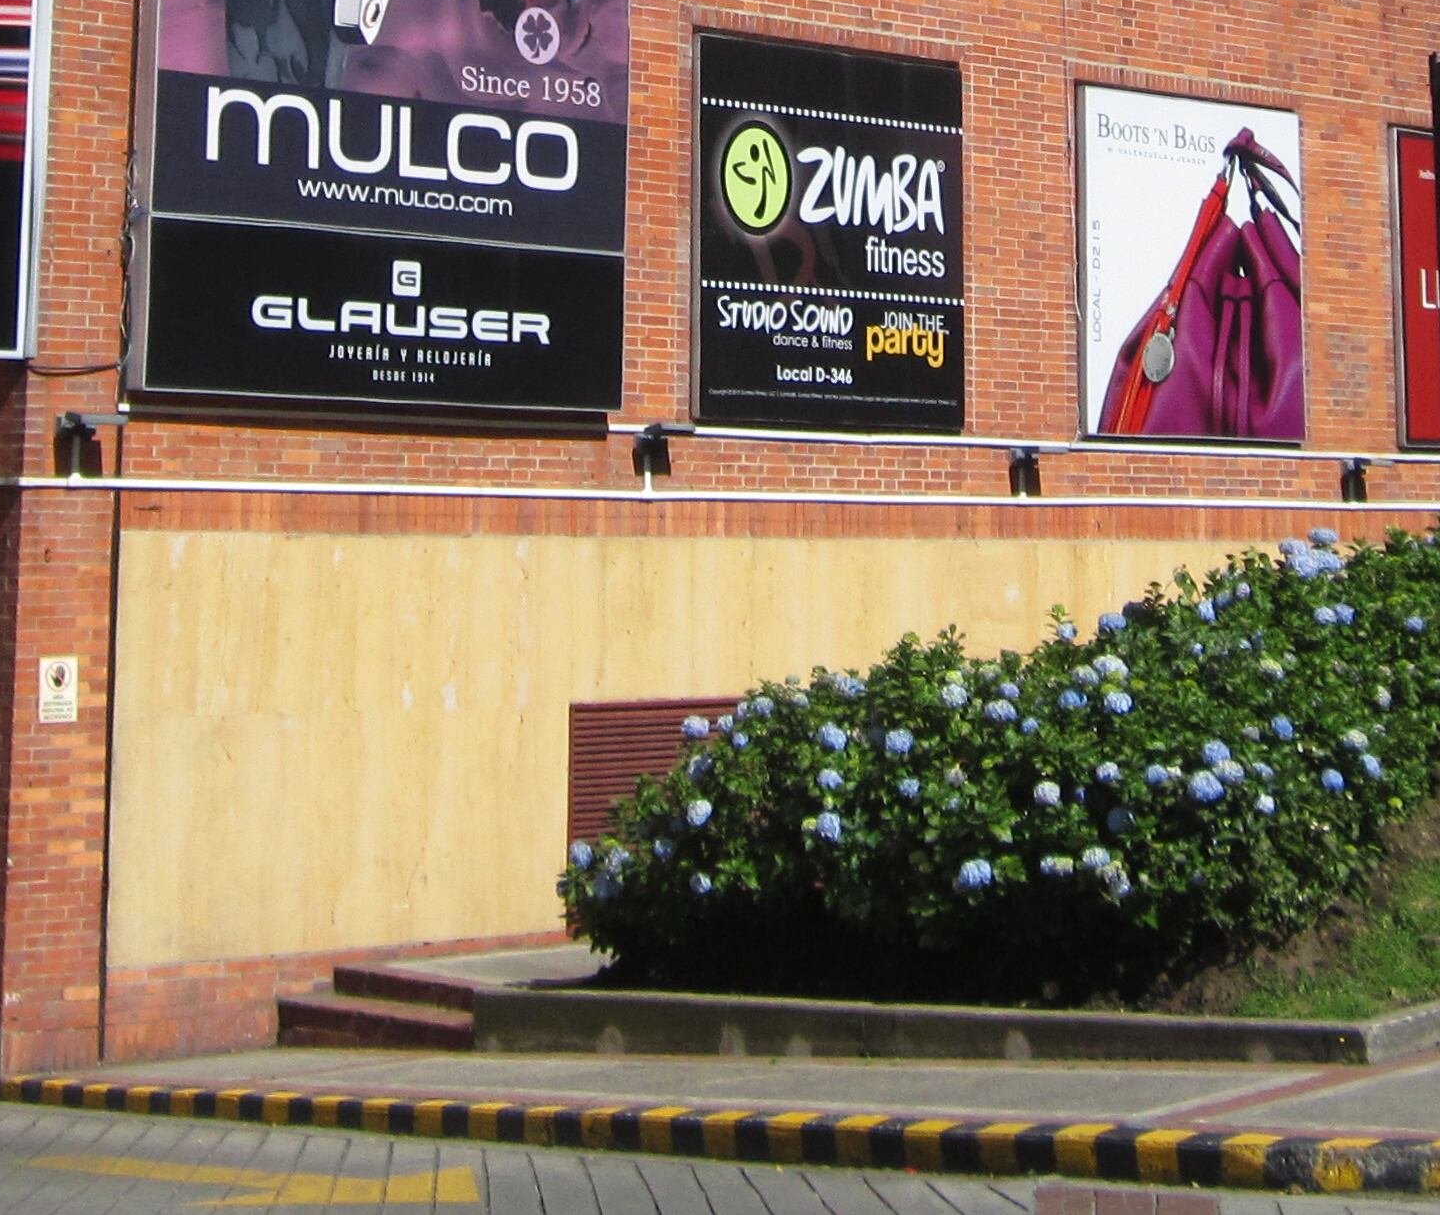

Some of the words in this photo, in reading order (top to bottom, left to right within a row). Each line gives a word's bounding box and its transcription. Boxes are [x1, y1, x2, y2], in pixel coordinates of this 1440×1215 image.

[460, 66, 531, 100] Since
[541, 76, 602, 108] 1958
[204, 85, 579, 192] MULCO
[1096, 112, 1151, 145] BOOTS
[1173, 124, 1216, 154] BAGS
[296, 177, 513, 217] www.mulco.com
[864, 235, 946, 279] fitness
[1091, 219, 1101, 269] D215
[250, 294, 552, 346] GLAUSER
[716, 294, 788, 334] STUDIO
[789, 300, 854, 336] SOUND
[881, 310, 914, 332] JOIN
[916, 313, 946, 333] THE
[1092, 286, 1103, 344] LOCAL
[328, 343, 390, 362] JOYERÍA
[400, 348, 408, 363] Y
[417, 348, 493, 368] RELOJERÍA
[772, 333, 809, 347] dance
[822, 335, 853, 351] fitness
[865, 322, 946, 369] party
[372, 369, 406, 383] DESDE
[776, 364, 813, 382] Local
[815, 367, 853, 385] D-346
